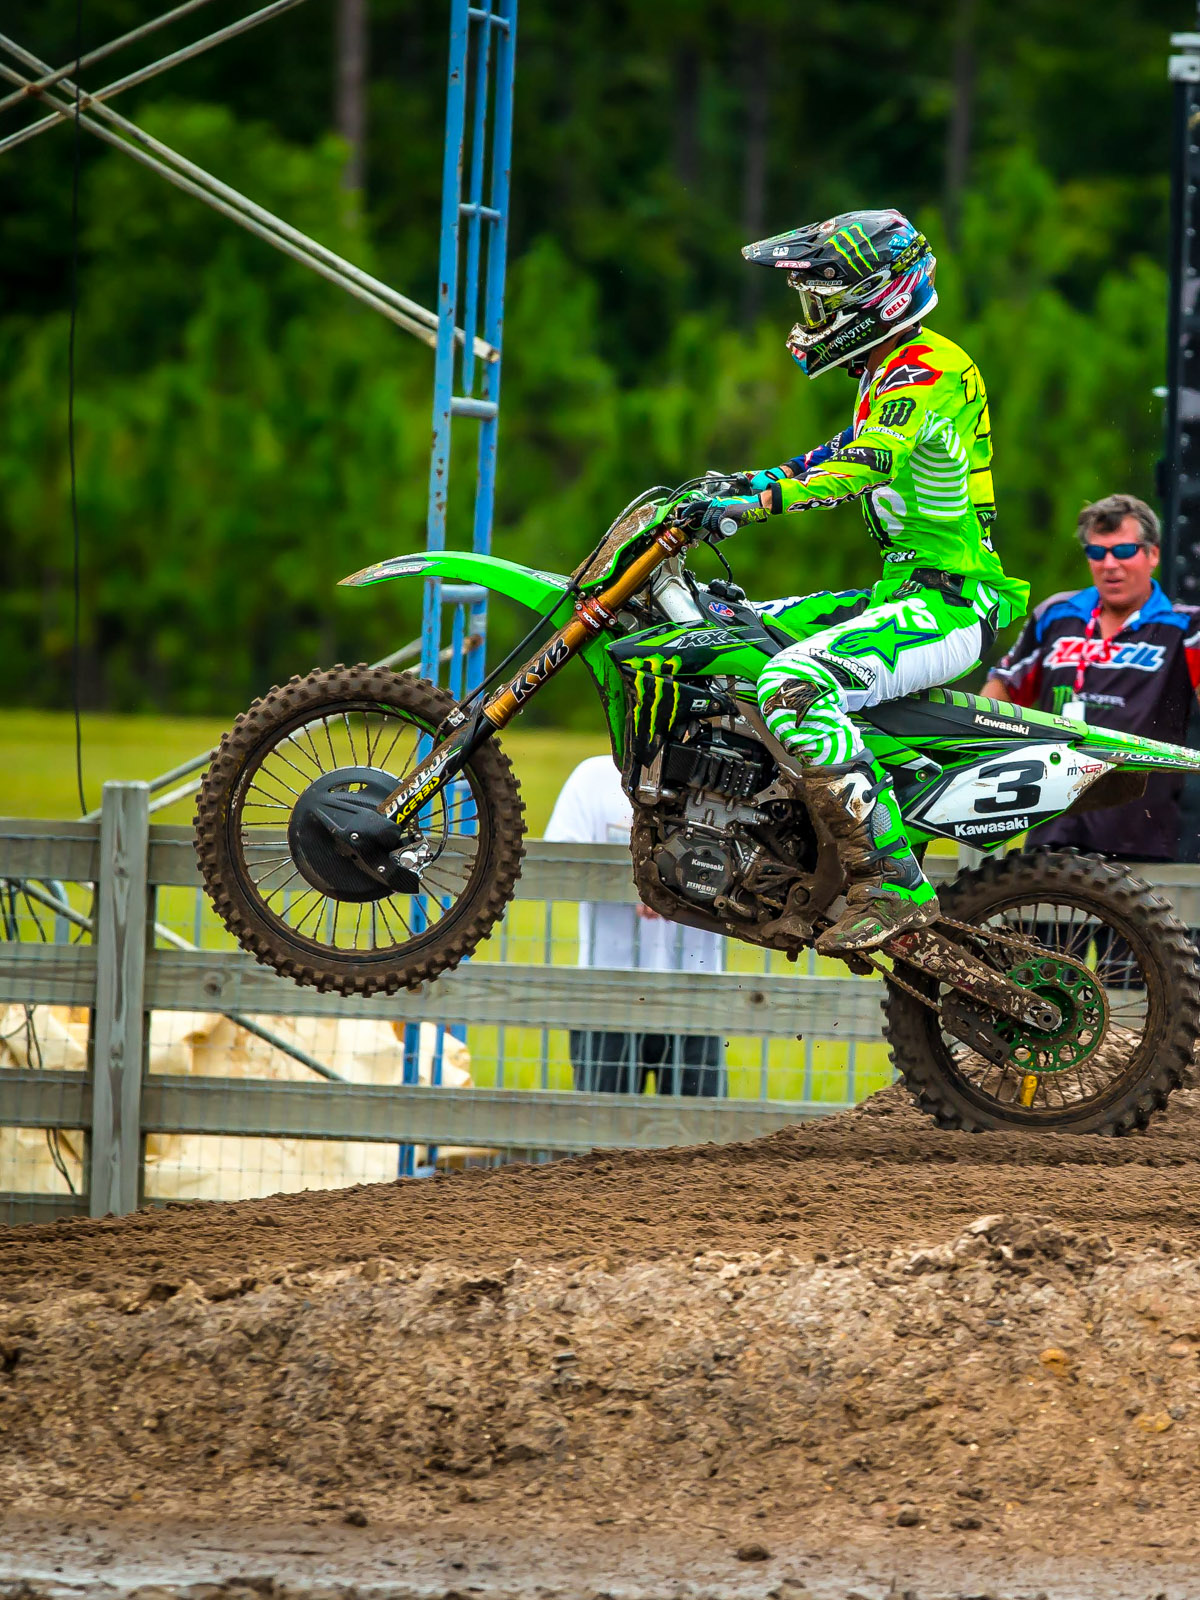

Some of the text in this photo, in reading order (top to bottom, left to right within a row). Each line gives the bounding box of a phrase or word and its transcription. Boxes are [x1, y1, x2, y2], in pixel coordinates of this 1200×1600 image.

[885, 298, 908, 317] BELL
[829, 317, 876, 349] MONSTER
[677, 630, 728, 649] KX
[510, 638, 569, 703] KYB
[809, 647, 876, 688] Kawasaki
[974, 714, 1030, 736] Kawasaki
[974, 760, 1044, 814] 3
[954, 816, 1029, 837] Kawasaki
[691, 858, 725, 872] Kawasaki
